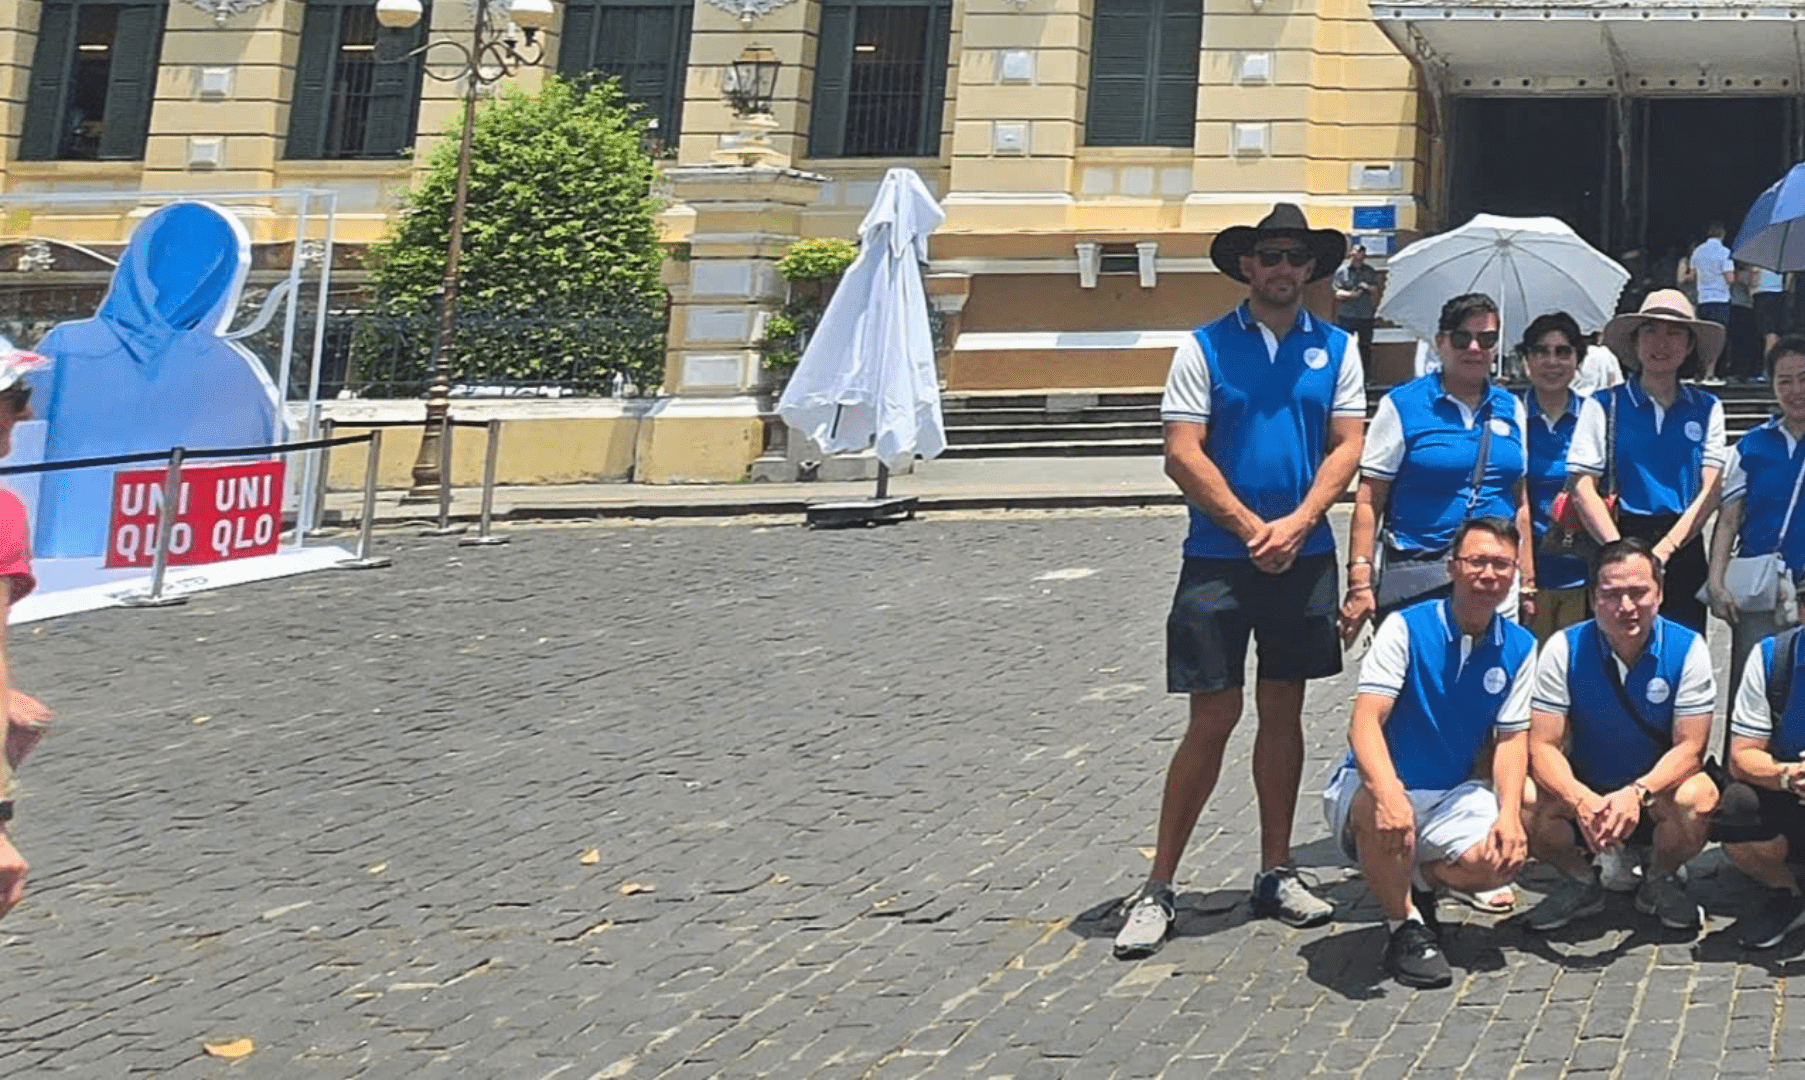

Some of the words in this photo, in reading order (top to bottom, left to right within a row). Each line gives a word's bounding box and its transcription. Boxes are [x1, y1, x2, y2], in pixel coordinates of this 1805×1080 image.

[120, 482, 190, 516] UNI
[215, 474, 272, 512] UNI
[116, 522, 192, 562] QLO
[212, 513, 273, 557] QLO
